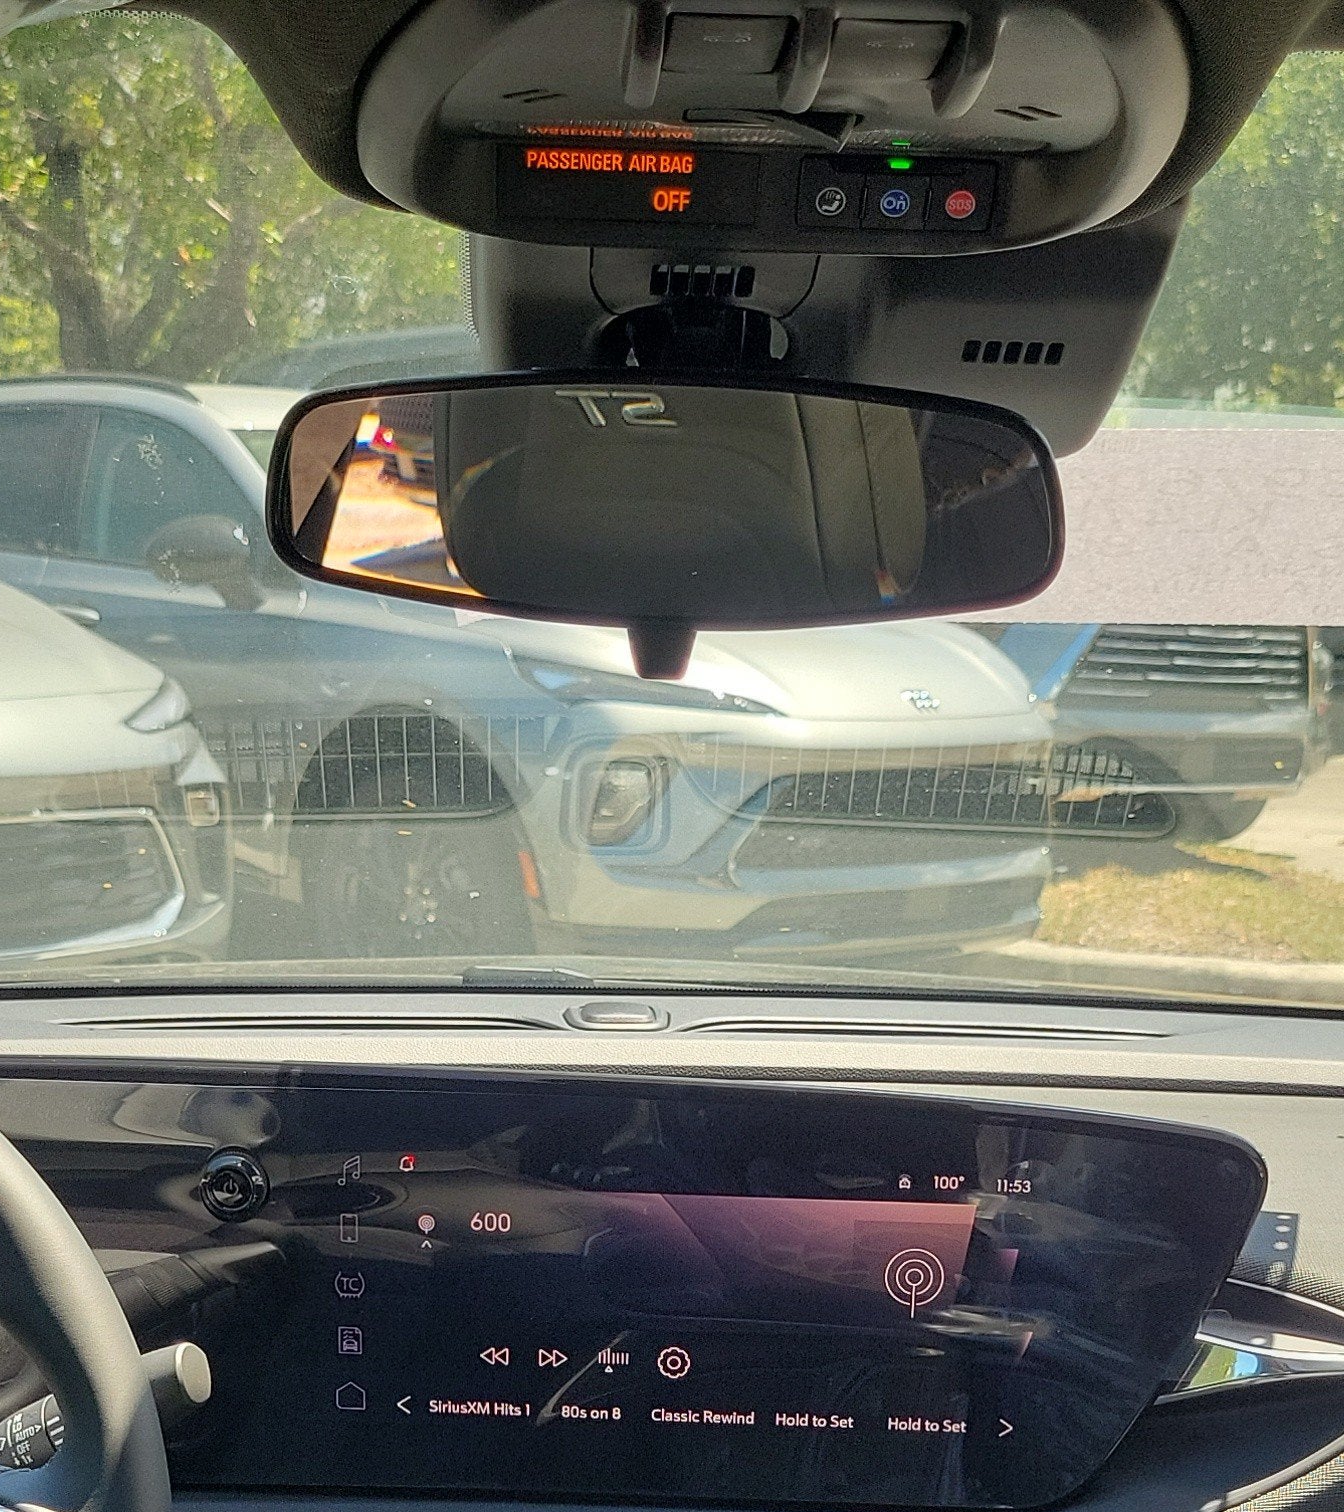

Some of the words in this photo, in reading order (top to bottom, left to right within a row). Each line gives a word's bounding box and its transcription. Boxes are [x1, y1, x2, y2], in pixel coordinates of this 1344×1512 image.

[527, 151, 623, 171] PASSENGER
[629, 154, 656, 173] AIR
[659, 156, 693, 174] BAG
[653, 190, 692, 212] OFF
[948, 199, 972, 211] SOS
[997, 1179, 1032, 1193] 11:53
[470, 1212, 512, 1233] 600
[340, 1277, 359, 1291] TC
[429, 1400, 490, 1415] SiriusXM
[494, 1403, 521, 1417] Hits
[525, 1403, 531, 1417] 1
[561, 1405, 587, 1419] 80s
[591, 1408, 608, 1420] on
[612, 1407, 621, 1420] 8
[651, 1408, 700, 1423] Classic
[703, 1410, 755, 1425] Rewind
[775, 1413, 808, 1427] Hold
[812, 1415, 827, 1428] to
[830, 1415, 854, 1429] Set
[887, 1417, 921, 1431] Hold
[924, 1418, 939, 1432] to
[942, 1420, 966, 1433] Set
[15, 1426, 35, 1443] AUTO
[16, 1441, 31, 1454] OFF
